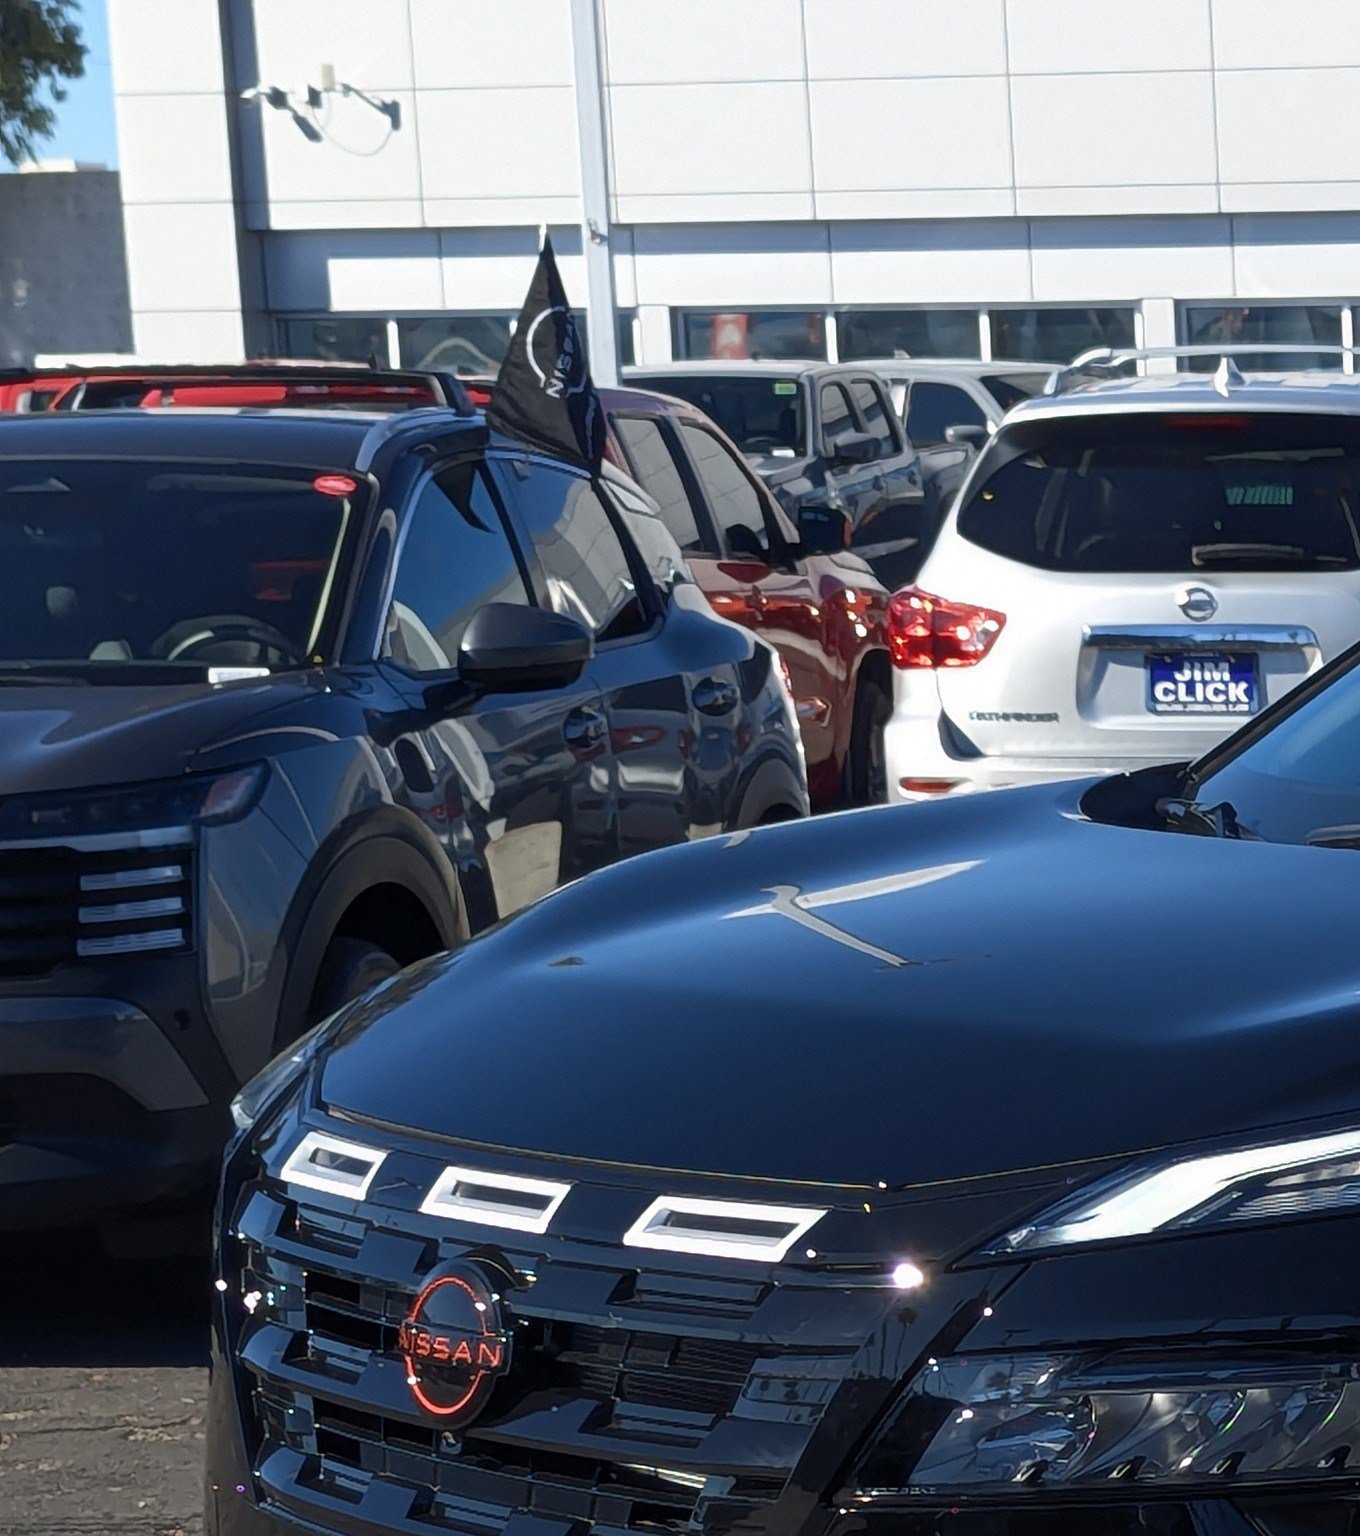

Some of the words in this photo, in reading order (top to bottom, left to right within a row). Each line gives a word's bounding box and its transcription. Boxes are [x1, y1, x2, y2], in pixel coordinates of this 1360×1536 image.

[1173, 661, 1231, 681] JIM
[1153, 681, 1250, 703] CLICK
[399, 1326, 503, 1368] NISSAN
